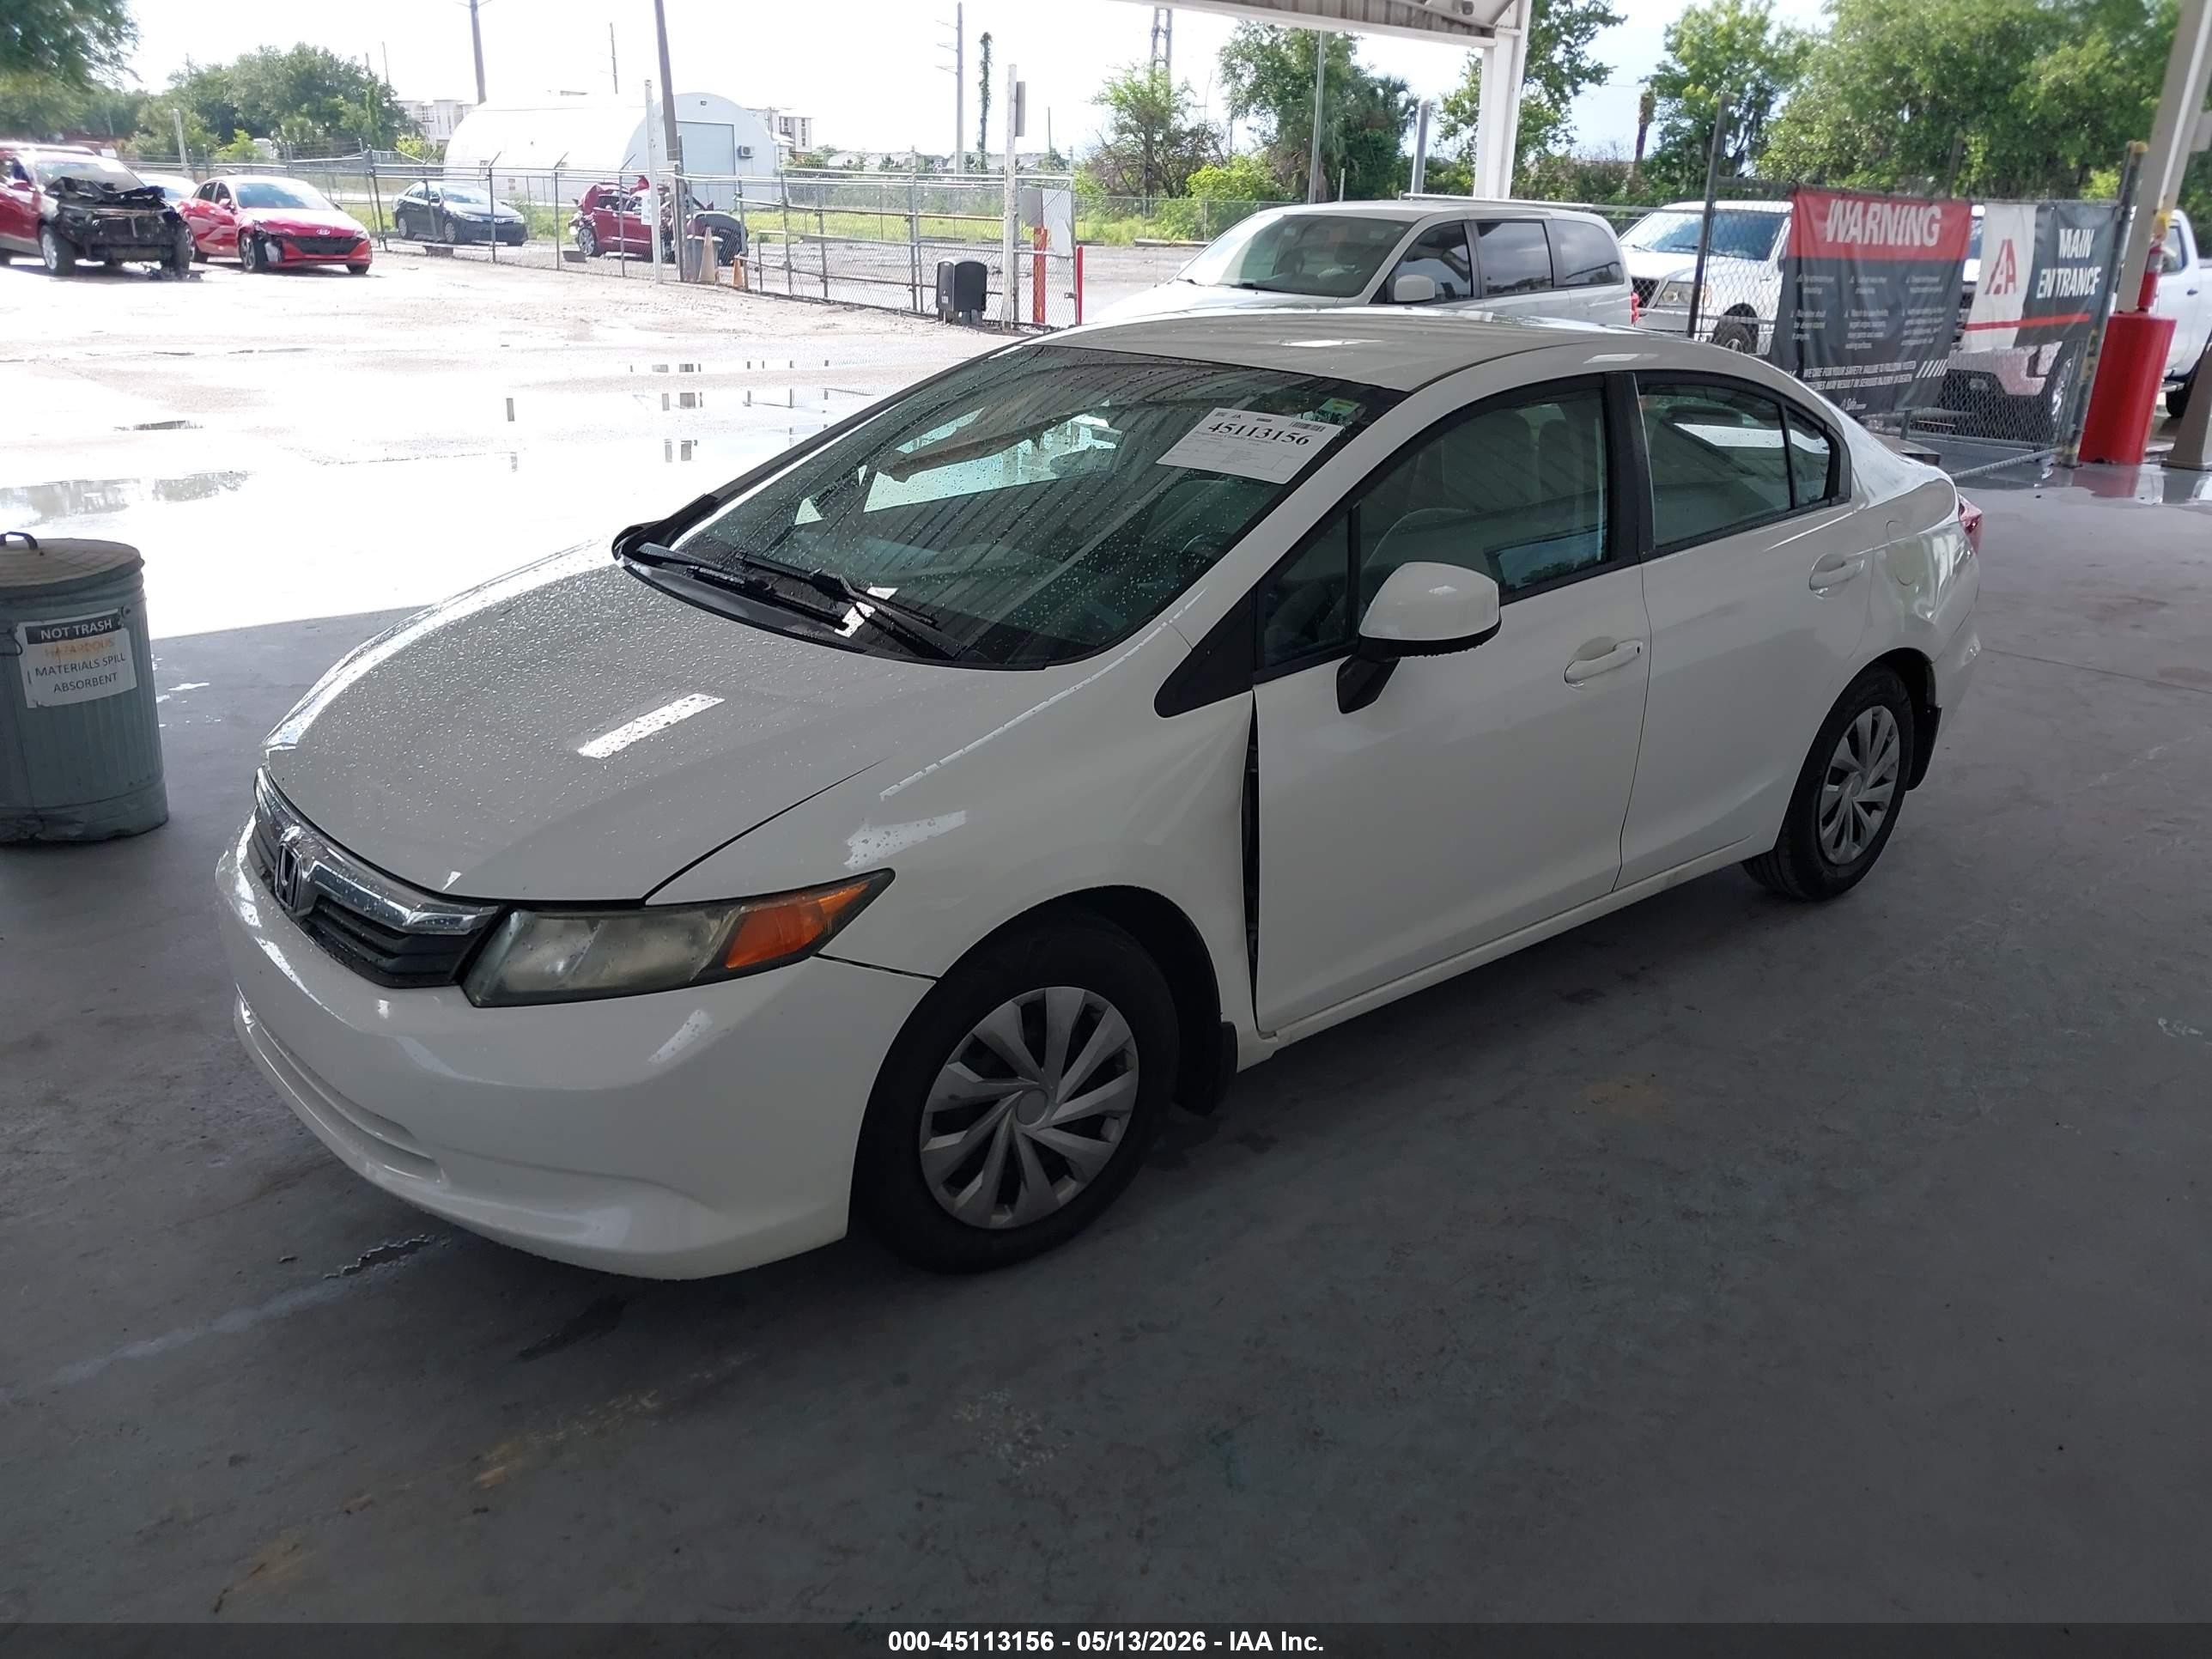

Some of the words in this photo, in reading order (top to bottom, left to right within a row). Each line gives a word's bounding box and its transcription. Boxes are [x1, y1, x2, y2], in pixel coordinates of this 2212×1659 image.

[1826, 198, 1942, 247] WARNING
[2058, 228, 2095, 258] MAIN
[2036, 266, 2102, 299] ENTRANCE
[1208, 422, 1313, 446] 45113156
[40, 627, 70, 641] NOT
[73, 618, 112, 636] TRASH
[35, 659, 100, 678] MATERIALS
[102, 652, 126, 667] SPILL
[53, 672, 118, 693] ABSORBENT
